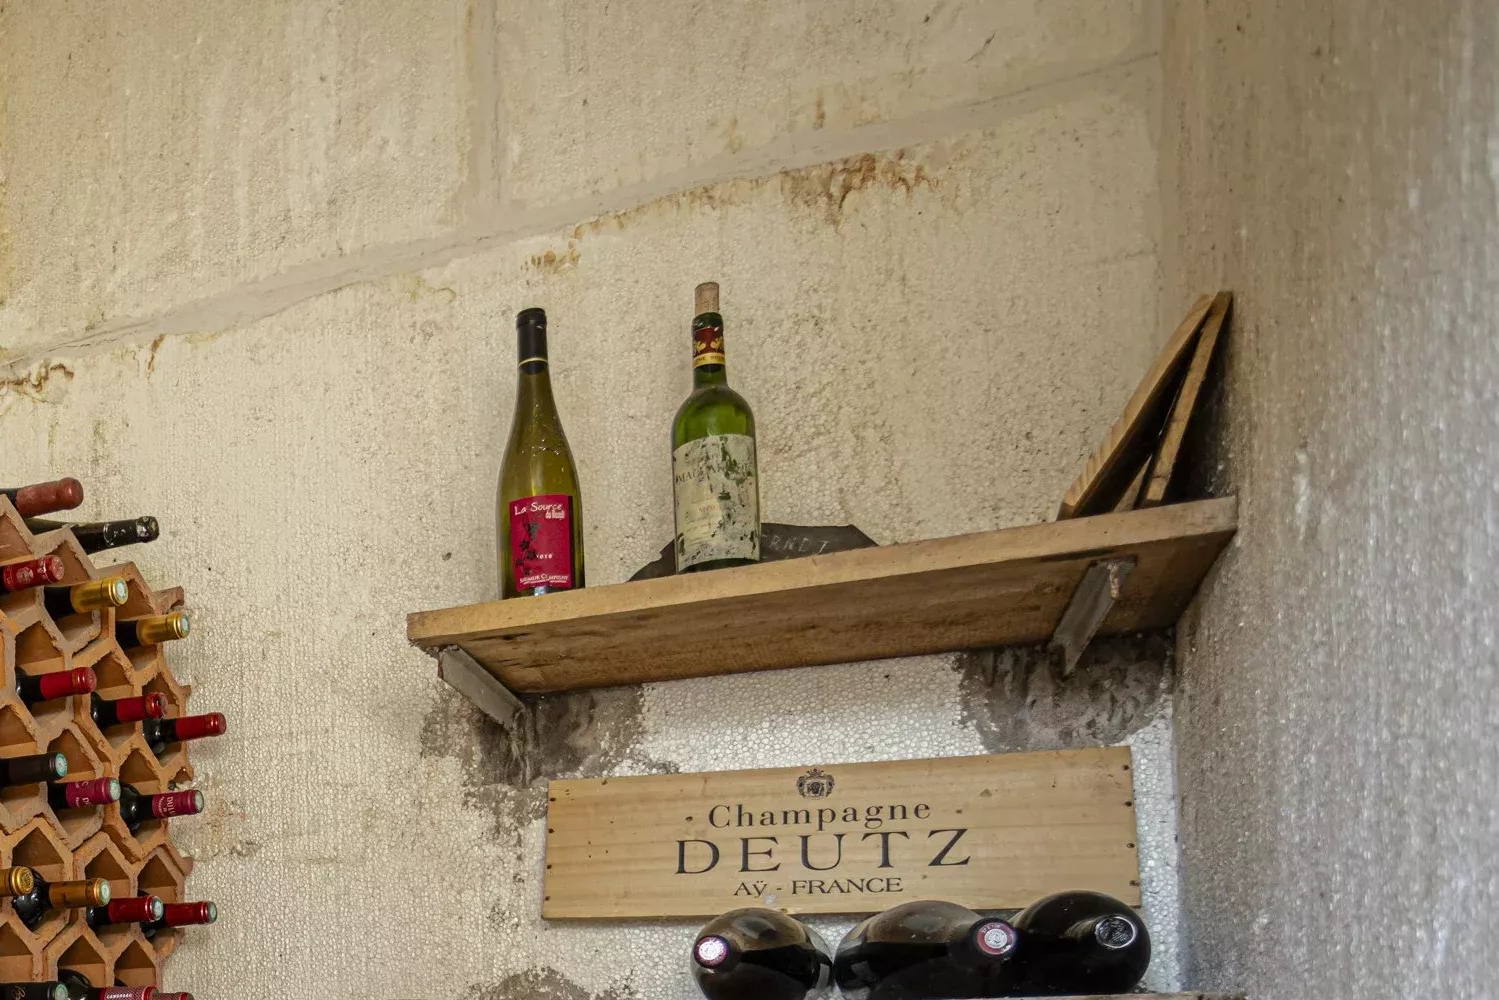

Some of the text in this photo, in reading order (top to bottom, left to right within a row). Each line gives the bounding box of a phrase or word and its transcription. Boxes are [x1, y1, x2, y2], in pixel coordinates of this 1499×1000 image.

[514, 501, 563, 516] La Source
[708, 802, 931, 831] Champagne
[675, 828, 971, 875] DEUTZ
[734, 879, 768, 898] Aÿ
[792, 877, 904, 895] FRANCE
